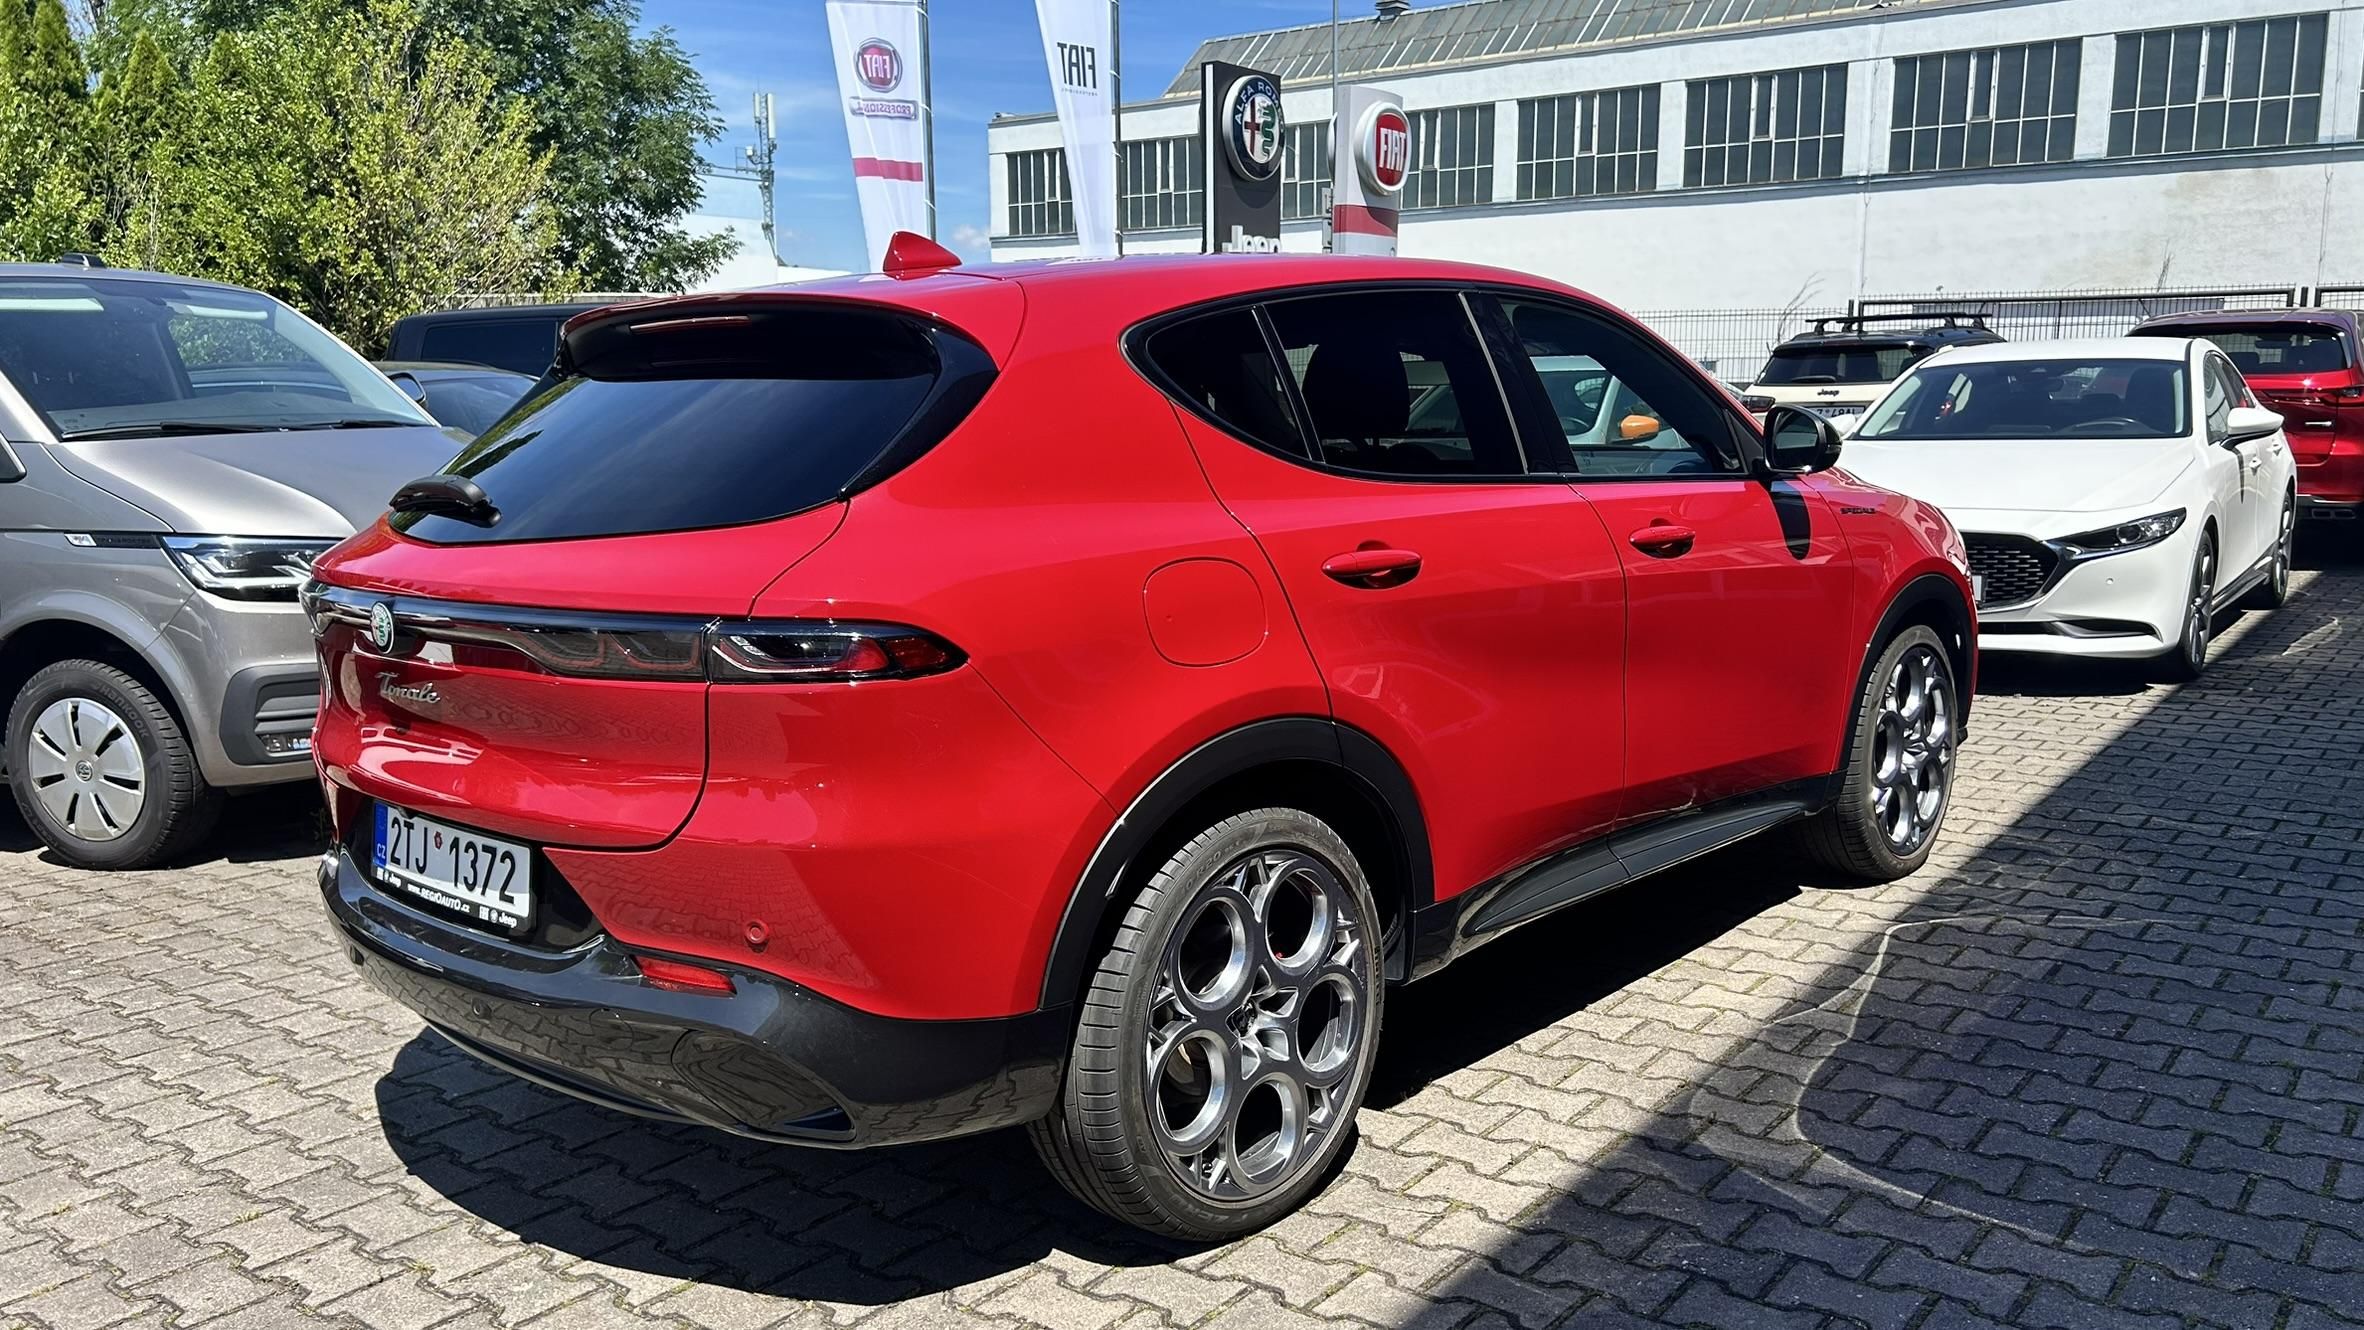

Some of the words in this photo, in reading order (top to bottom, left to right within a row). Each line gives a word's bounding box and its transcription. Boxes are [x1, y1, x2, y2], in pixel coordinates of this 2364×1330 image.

[1234, 84, 1256, 125] ALFA
[1378, 127, 1406, 172] FIAT
[374, 671, 441, 704] Tonale
[98, 683, 150, 738] Hankook
[376, 843, 387, 860] CZ
[390, 816, 428, 874] 2TJ
[448, 835, 517, 905] 1372
